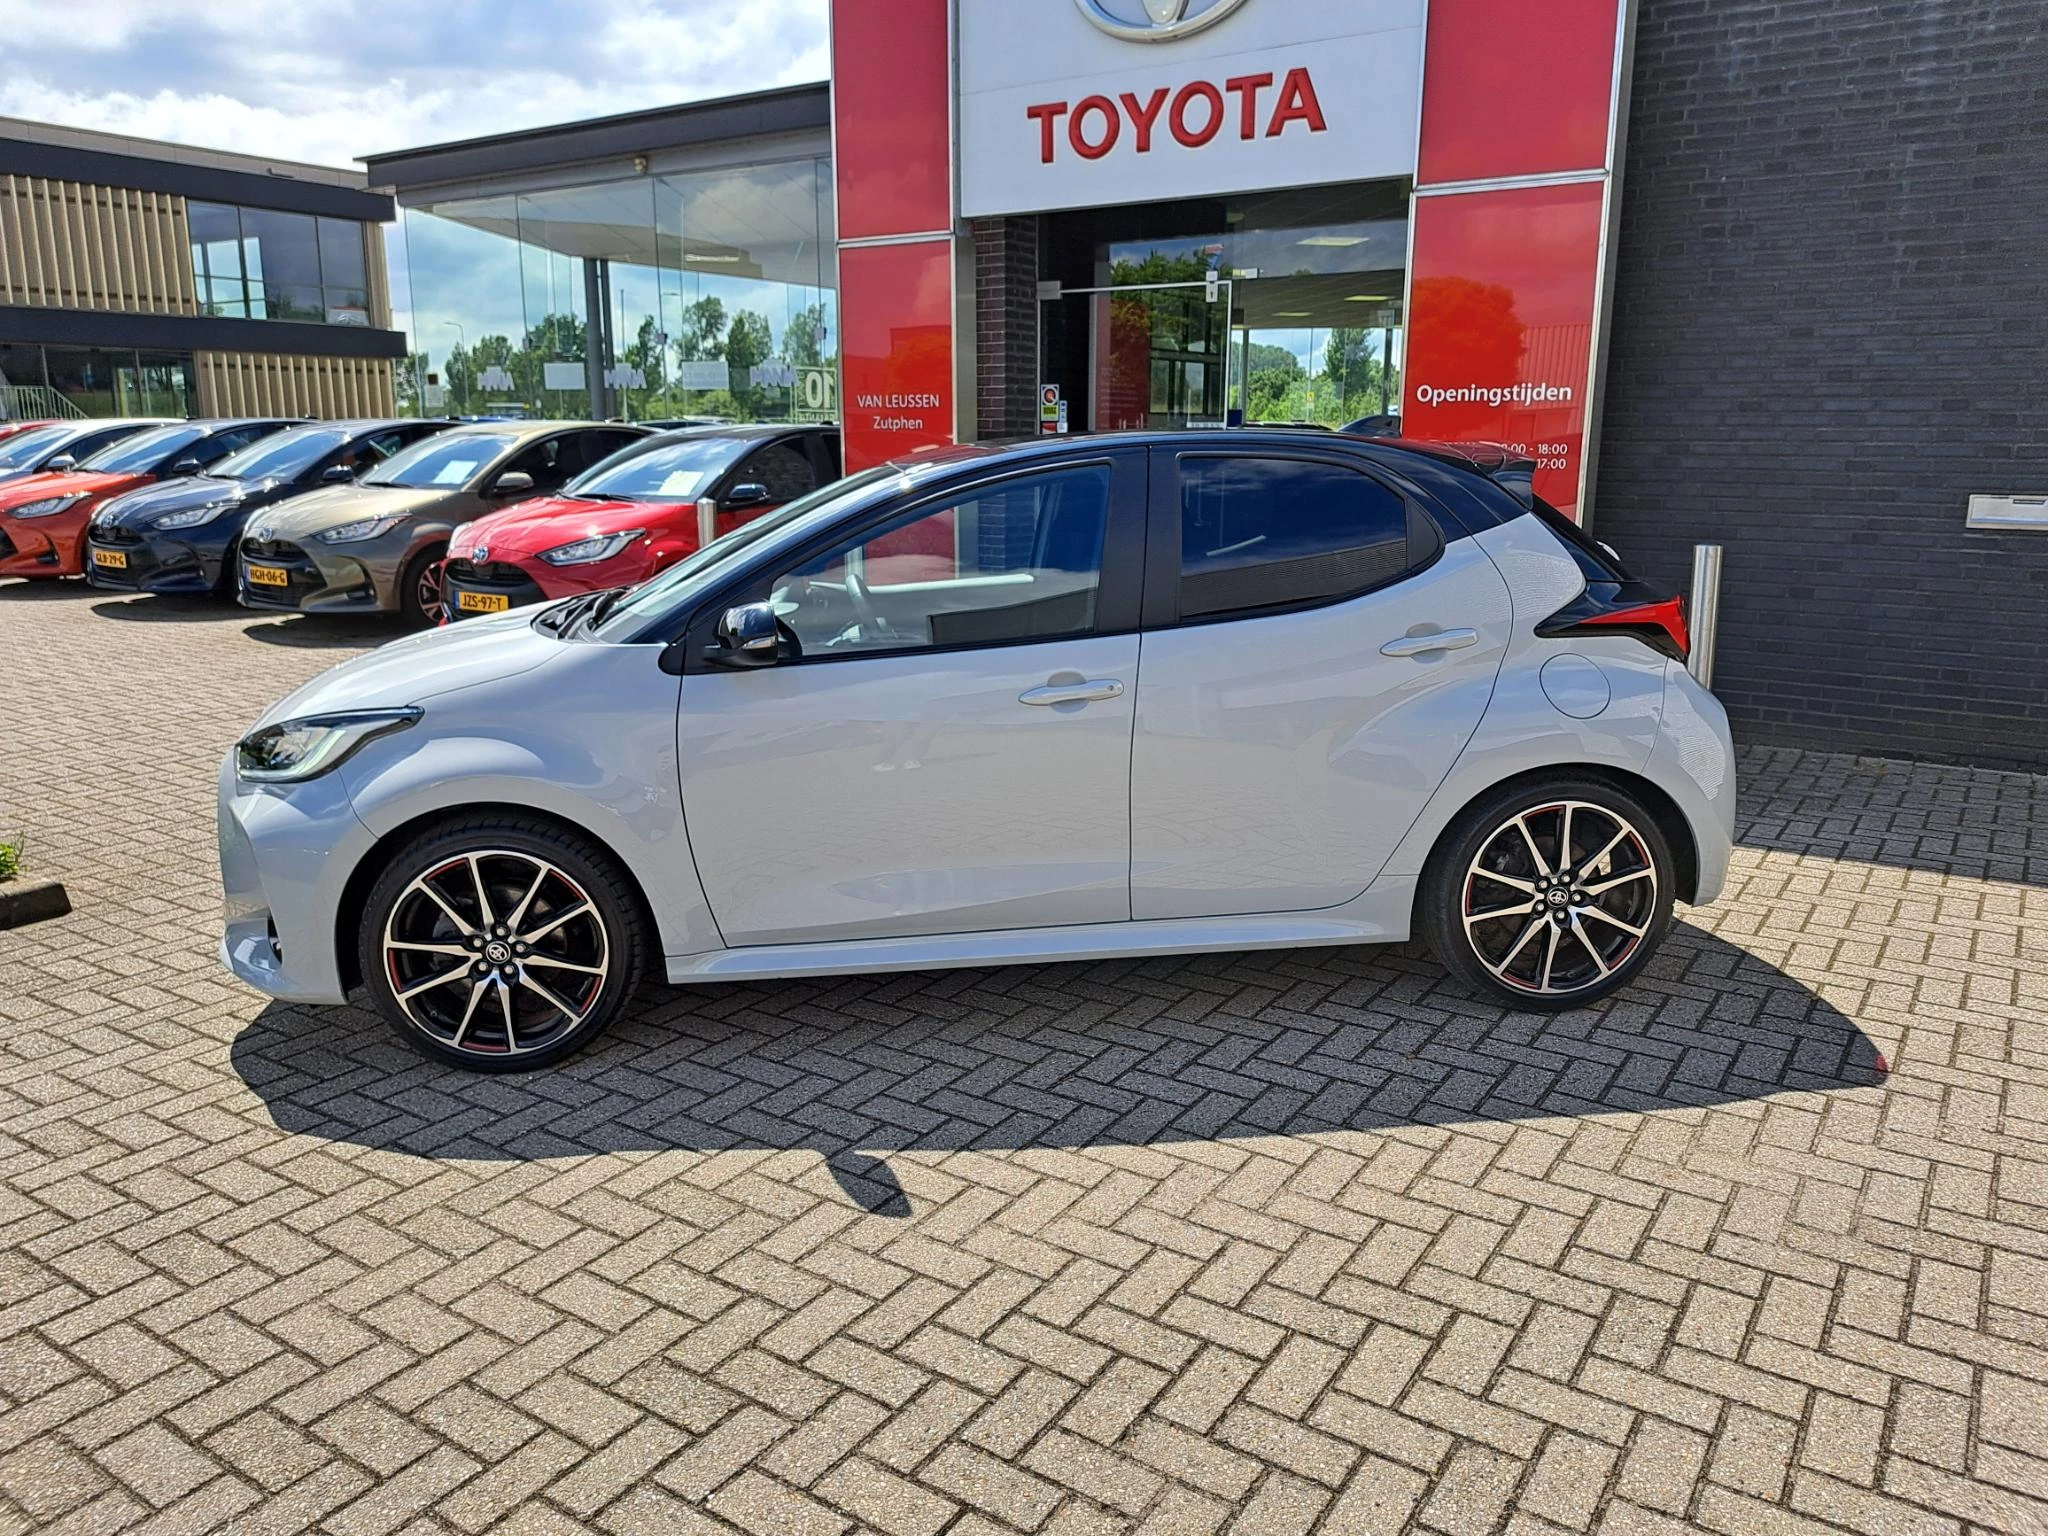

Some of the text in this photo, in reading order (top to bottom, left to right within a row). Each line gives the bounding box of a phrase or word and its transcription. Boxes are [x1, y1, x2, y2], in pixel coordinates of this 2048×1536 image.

[1027, 67, 1327, 163] TOYOTA
[857, 394, 940, 408] VAN LEUSSEN
[1416, 382, 1572, 408] Openingstijden
[873, 415, 923, 432] Zutphen
[1537, 443, 1568, 455] 18:00
[1536, 458, 1567, 470] 17:00
[462, 594, 502, 611] JZS-97-T
